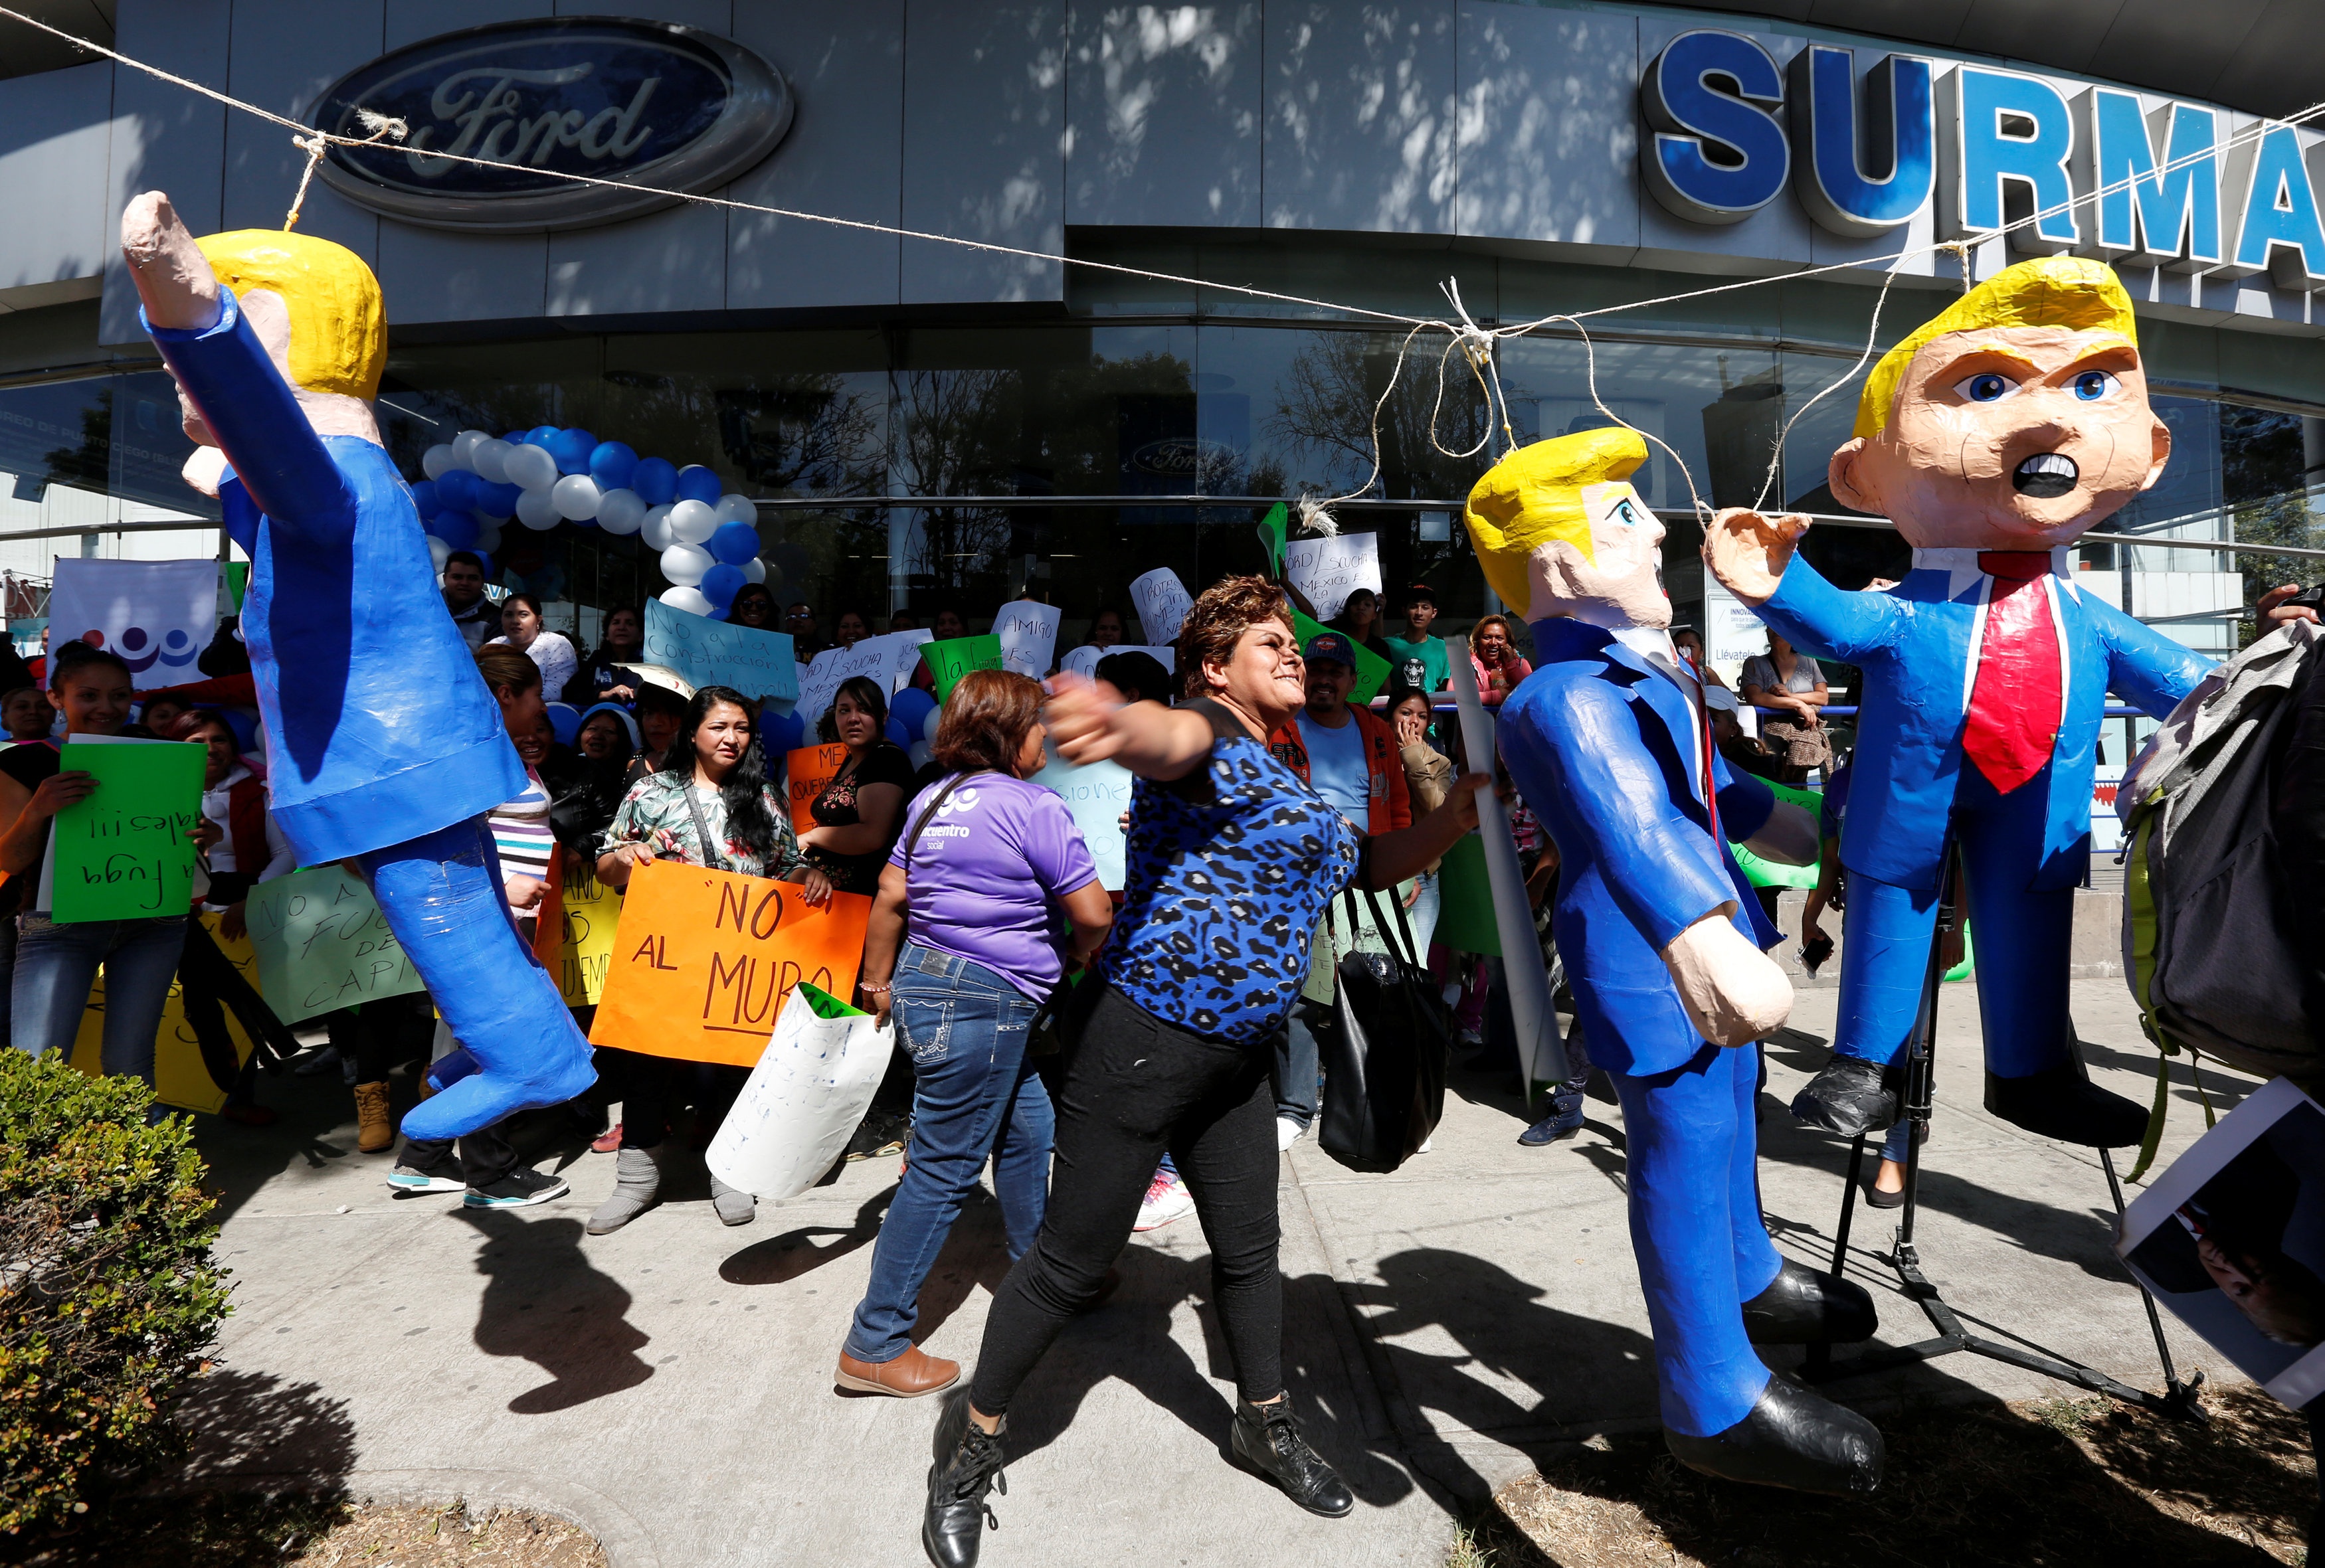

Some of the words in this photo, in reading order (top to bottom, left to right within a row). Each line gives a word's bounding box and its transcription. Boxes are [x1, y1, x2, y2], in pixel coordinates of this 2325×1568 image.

[407, 62, 662, 179] Ford
[0, 410, 33, 428] REO
[38, 420, 57, 435] DE
[61, 428, 108, 449] PUNTO
[1301, 576, 1348, 592] MEXICO
[1313, 590, 1329, 600] LA
[651, 603, 691, 640] No
[709, 632, 725, 647] a
[1004, 614, 1052, 640] AMIGO
[1008, 648, 1036, 664] ES
[921, 824, 971, 838] ncuentro
[927, 840, 945, 850] social
[261, 893, 306, 932] NO
[632, 934, 678, 971] AL
[304, 956, 417, 1008] CAPI
